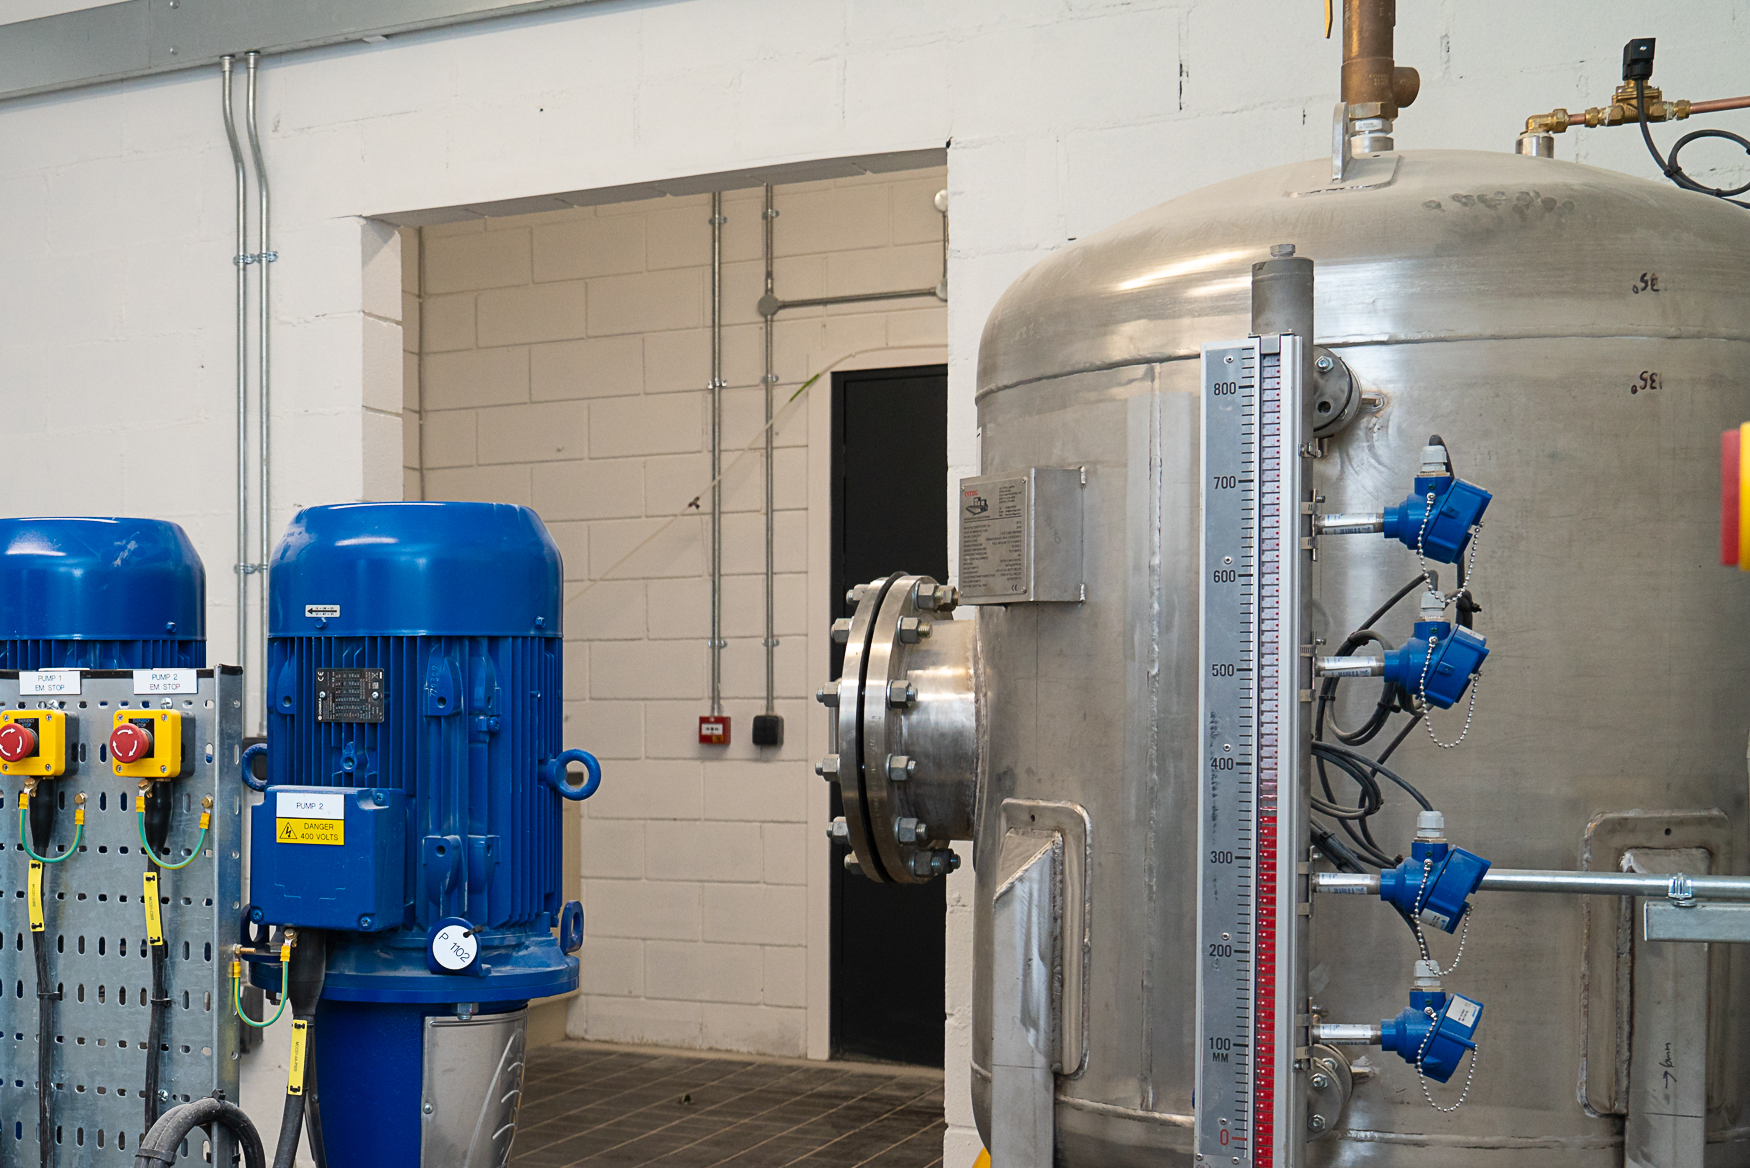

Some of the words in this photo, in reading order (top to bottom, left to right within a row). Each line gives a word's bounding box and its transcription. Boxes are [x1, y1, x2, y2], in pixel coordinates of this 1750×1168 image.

[1213, 382, 1237, 395] 800
[1213, 477, 1237, 489] 700
[1213, 570, 1236, 583] 600
[1211, 664, 1235, 677] 500
[1210, 757, 1234, 770] 400
[296, 802, 316, 810] PUMP
[319, 802, 324, 811] 2
[303, 822, 334, 831] DANGER
[316, 833, 339, 842] VOLTS
[1210, 852, 1233, 864] 300
[438, 931, 450, 942] P
[450, 942, 471, 963] 1102
[1209, 945, 1232, 957] 200
[1209, 1038, 1231, 1050] 100
[1212, 1052, 1229, 1063] MM
[1219, 1129, 1229, 1145] 0
